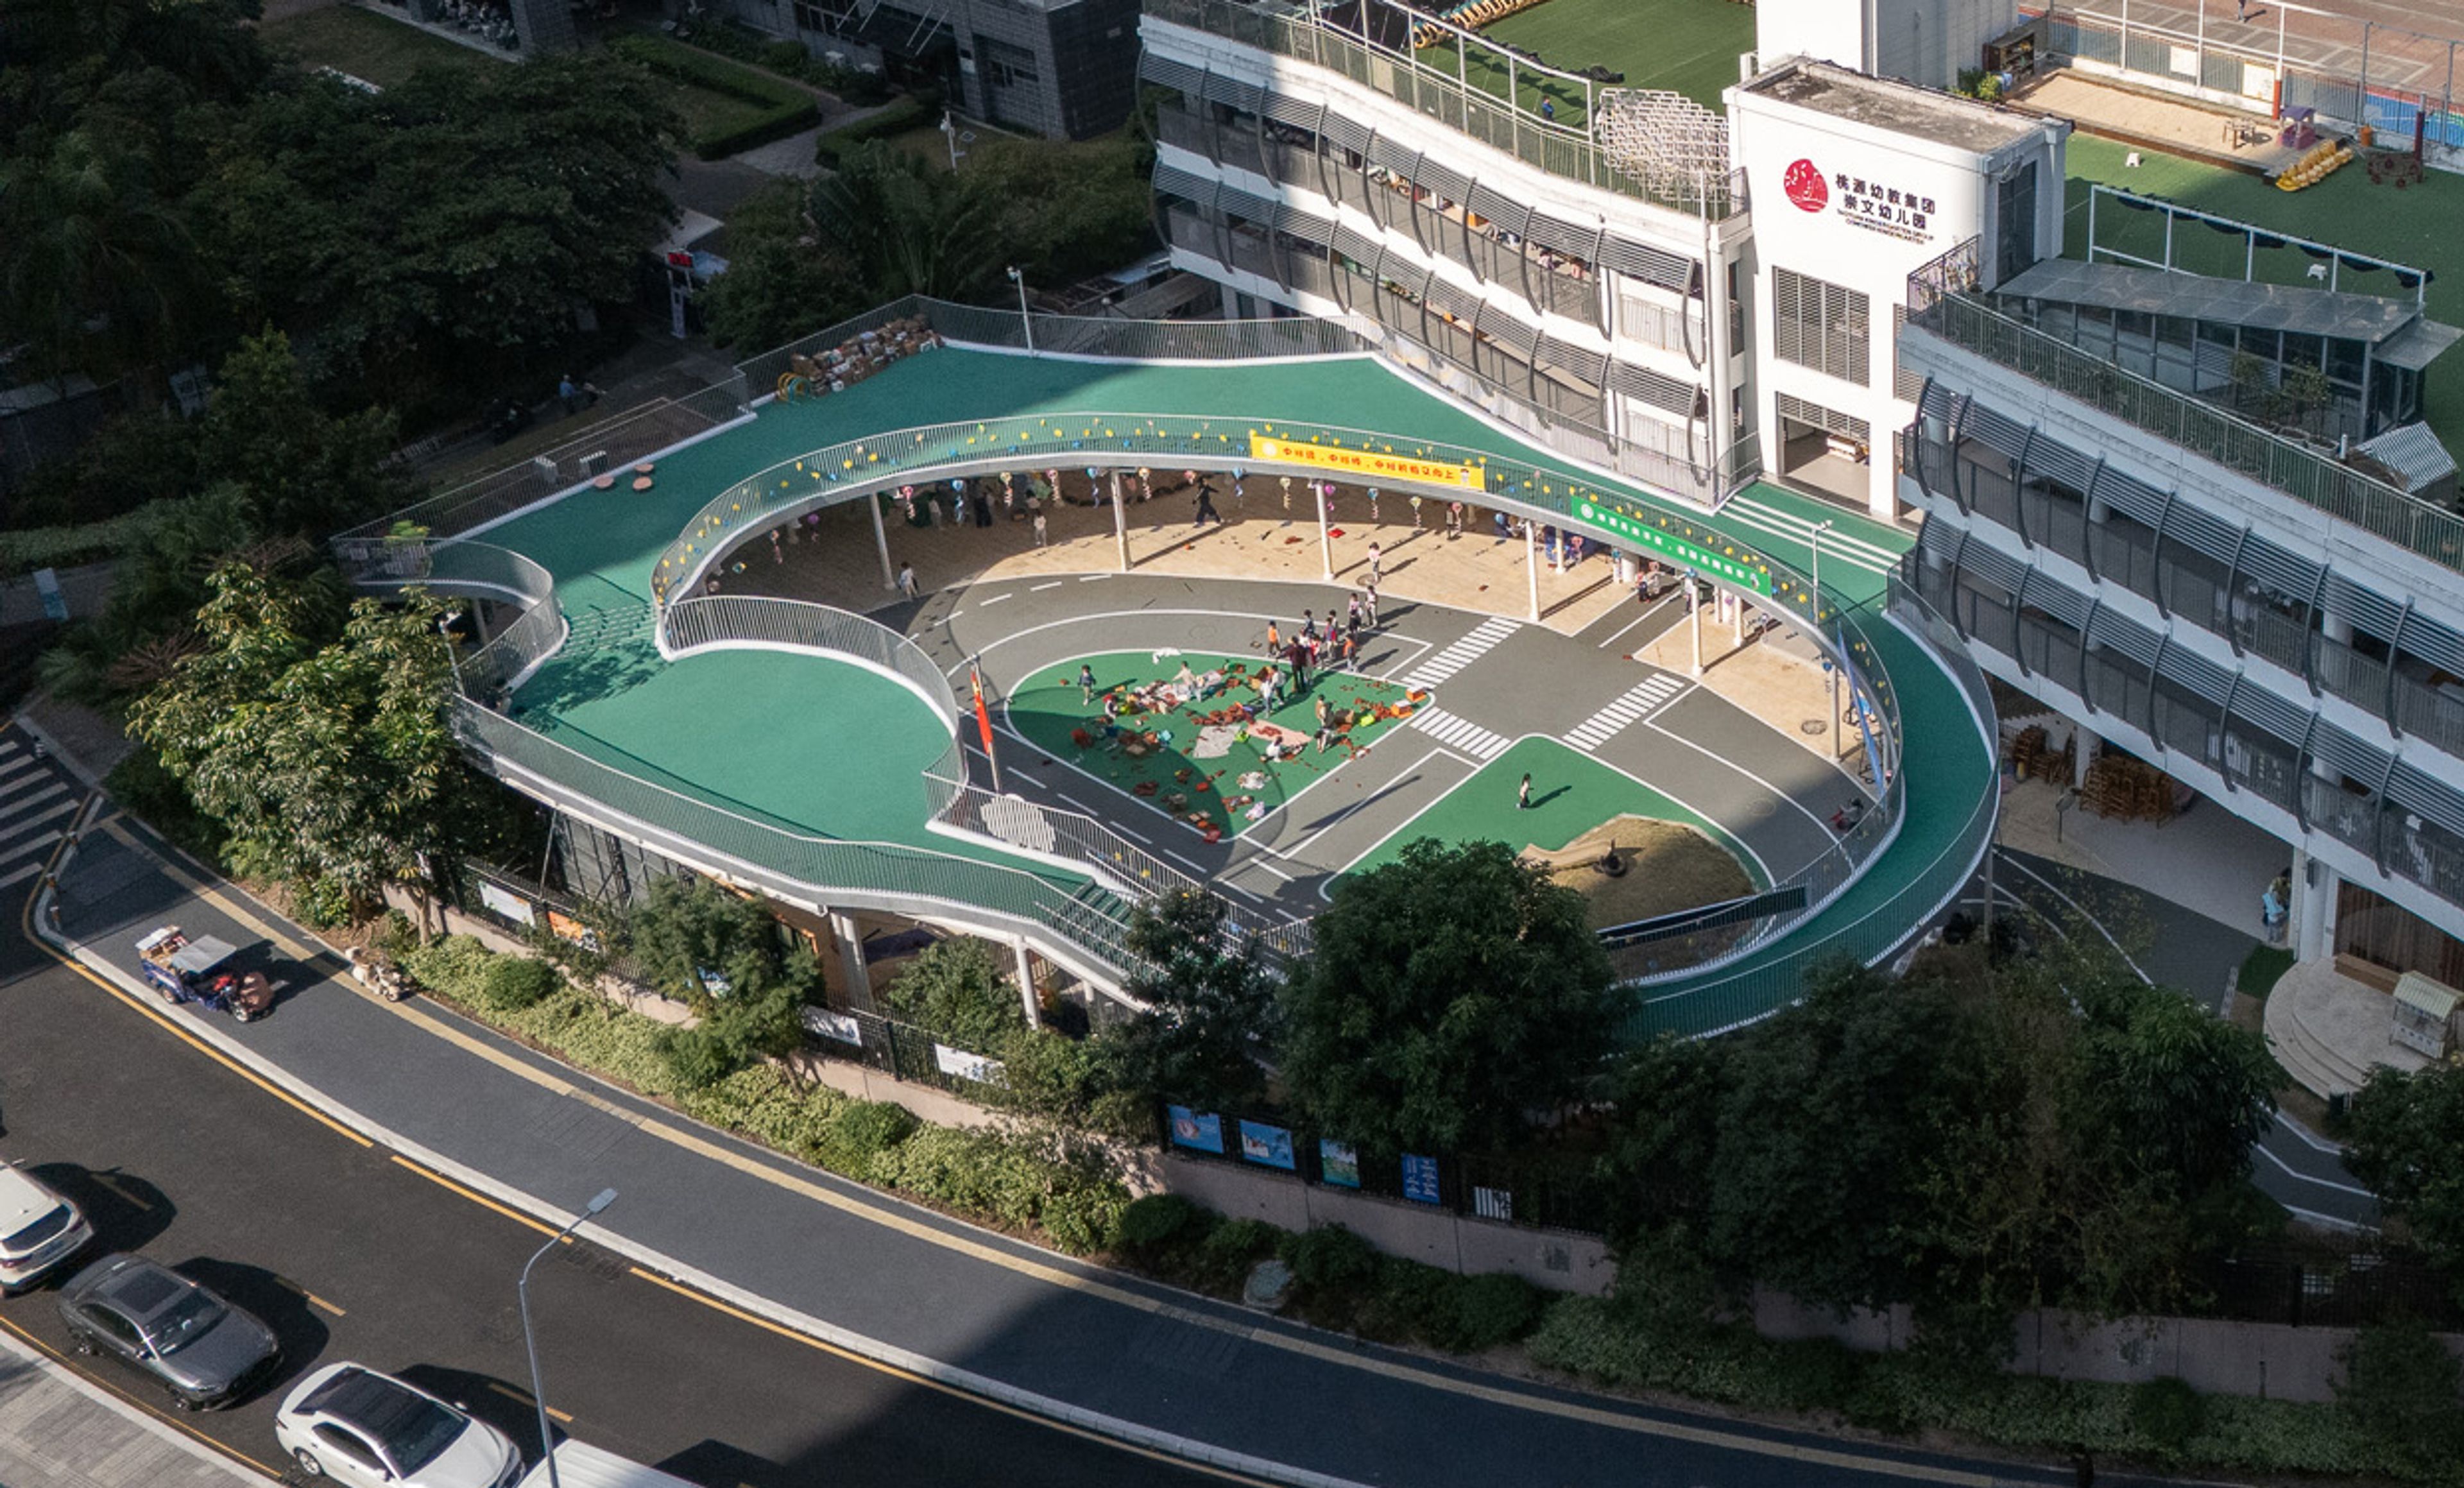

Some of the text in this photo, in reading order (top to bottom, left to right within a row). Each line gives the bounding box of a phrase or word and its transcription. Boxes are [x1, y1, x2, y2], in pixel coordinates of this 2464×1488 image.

[1836, 173, 1935, 214] 桃源幼教集团
[1844, 194, 1926, 230] 崇文幼儿园
